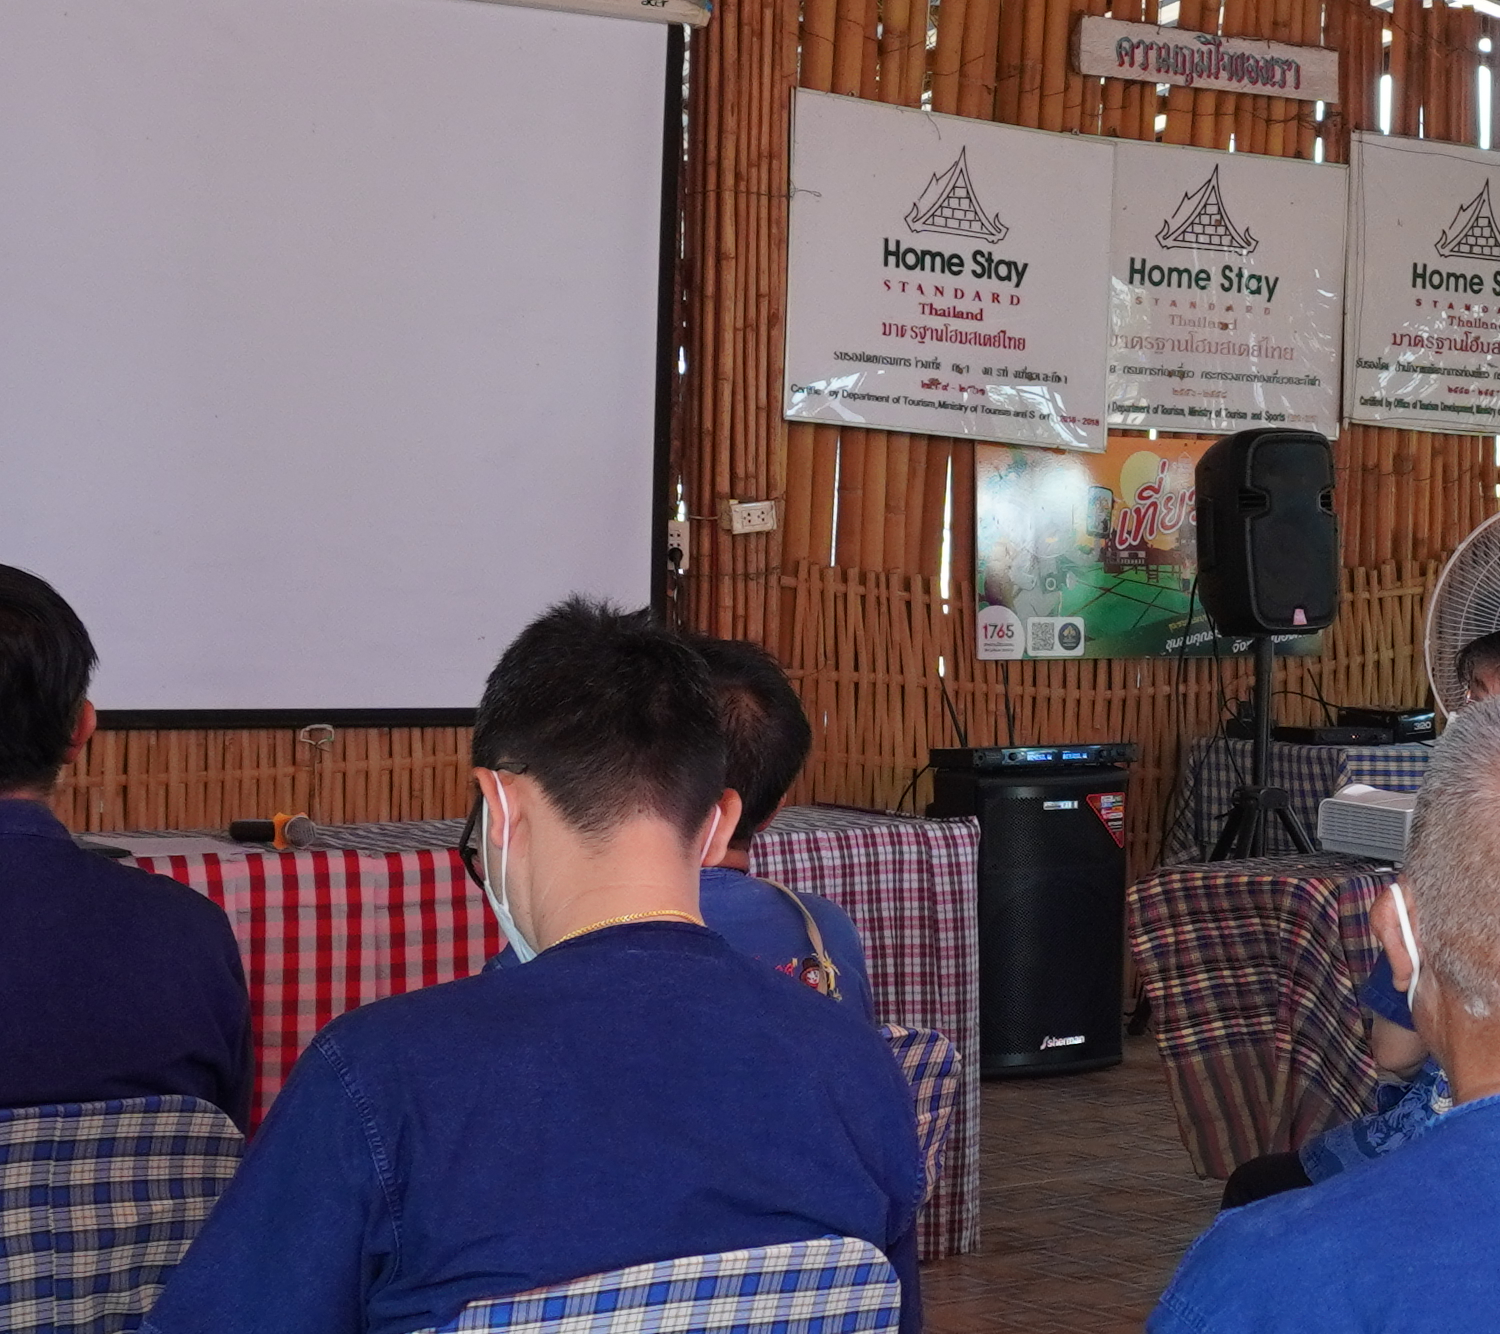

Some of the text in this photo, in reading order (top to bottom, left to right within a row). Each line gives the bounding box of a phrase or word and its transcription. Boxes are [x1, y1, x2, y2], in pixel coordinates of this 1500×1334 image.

[882, 237, 1029, 289] Home Stay
[1128, 257, 1280, 303] Home Stay
[1411, 262, 1484, 295] Home
[882, 278, 1022, 307] STANDARD
[918, 301, 985, 323] Thailand
[1134, 296, 1272, 316] STANDARD
[1168, 314, 1238, 331] Thailand
[982, 622, 1015, 640] 1765
[1040, 1034, 1086, 1051] sherman
